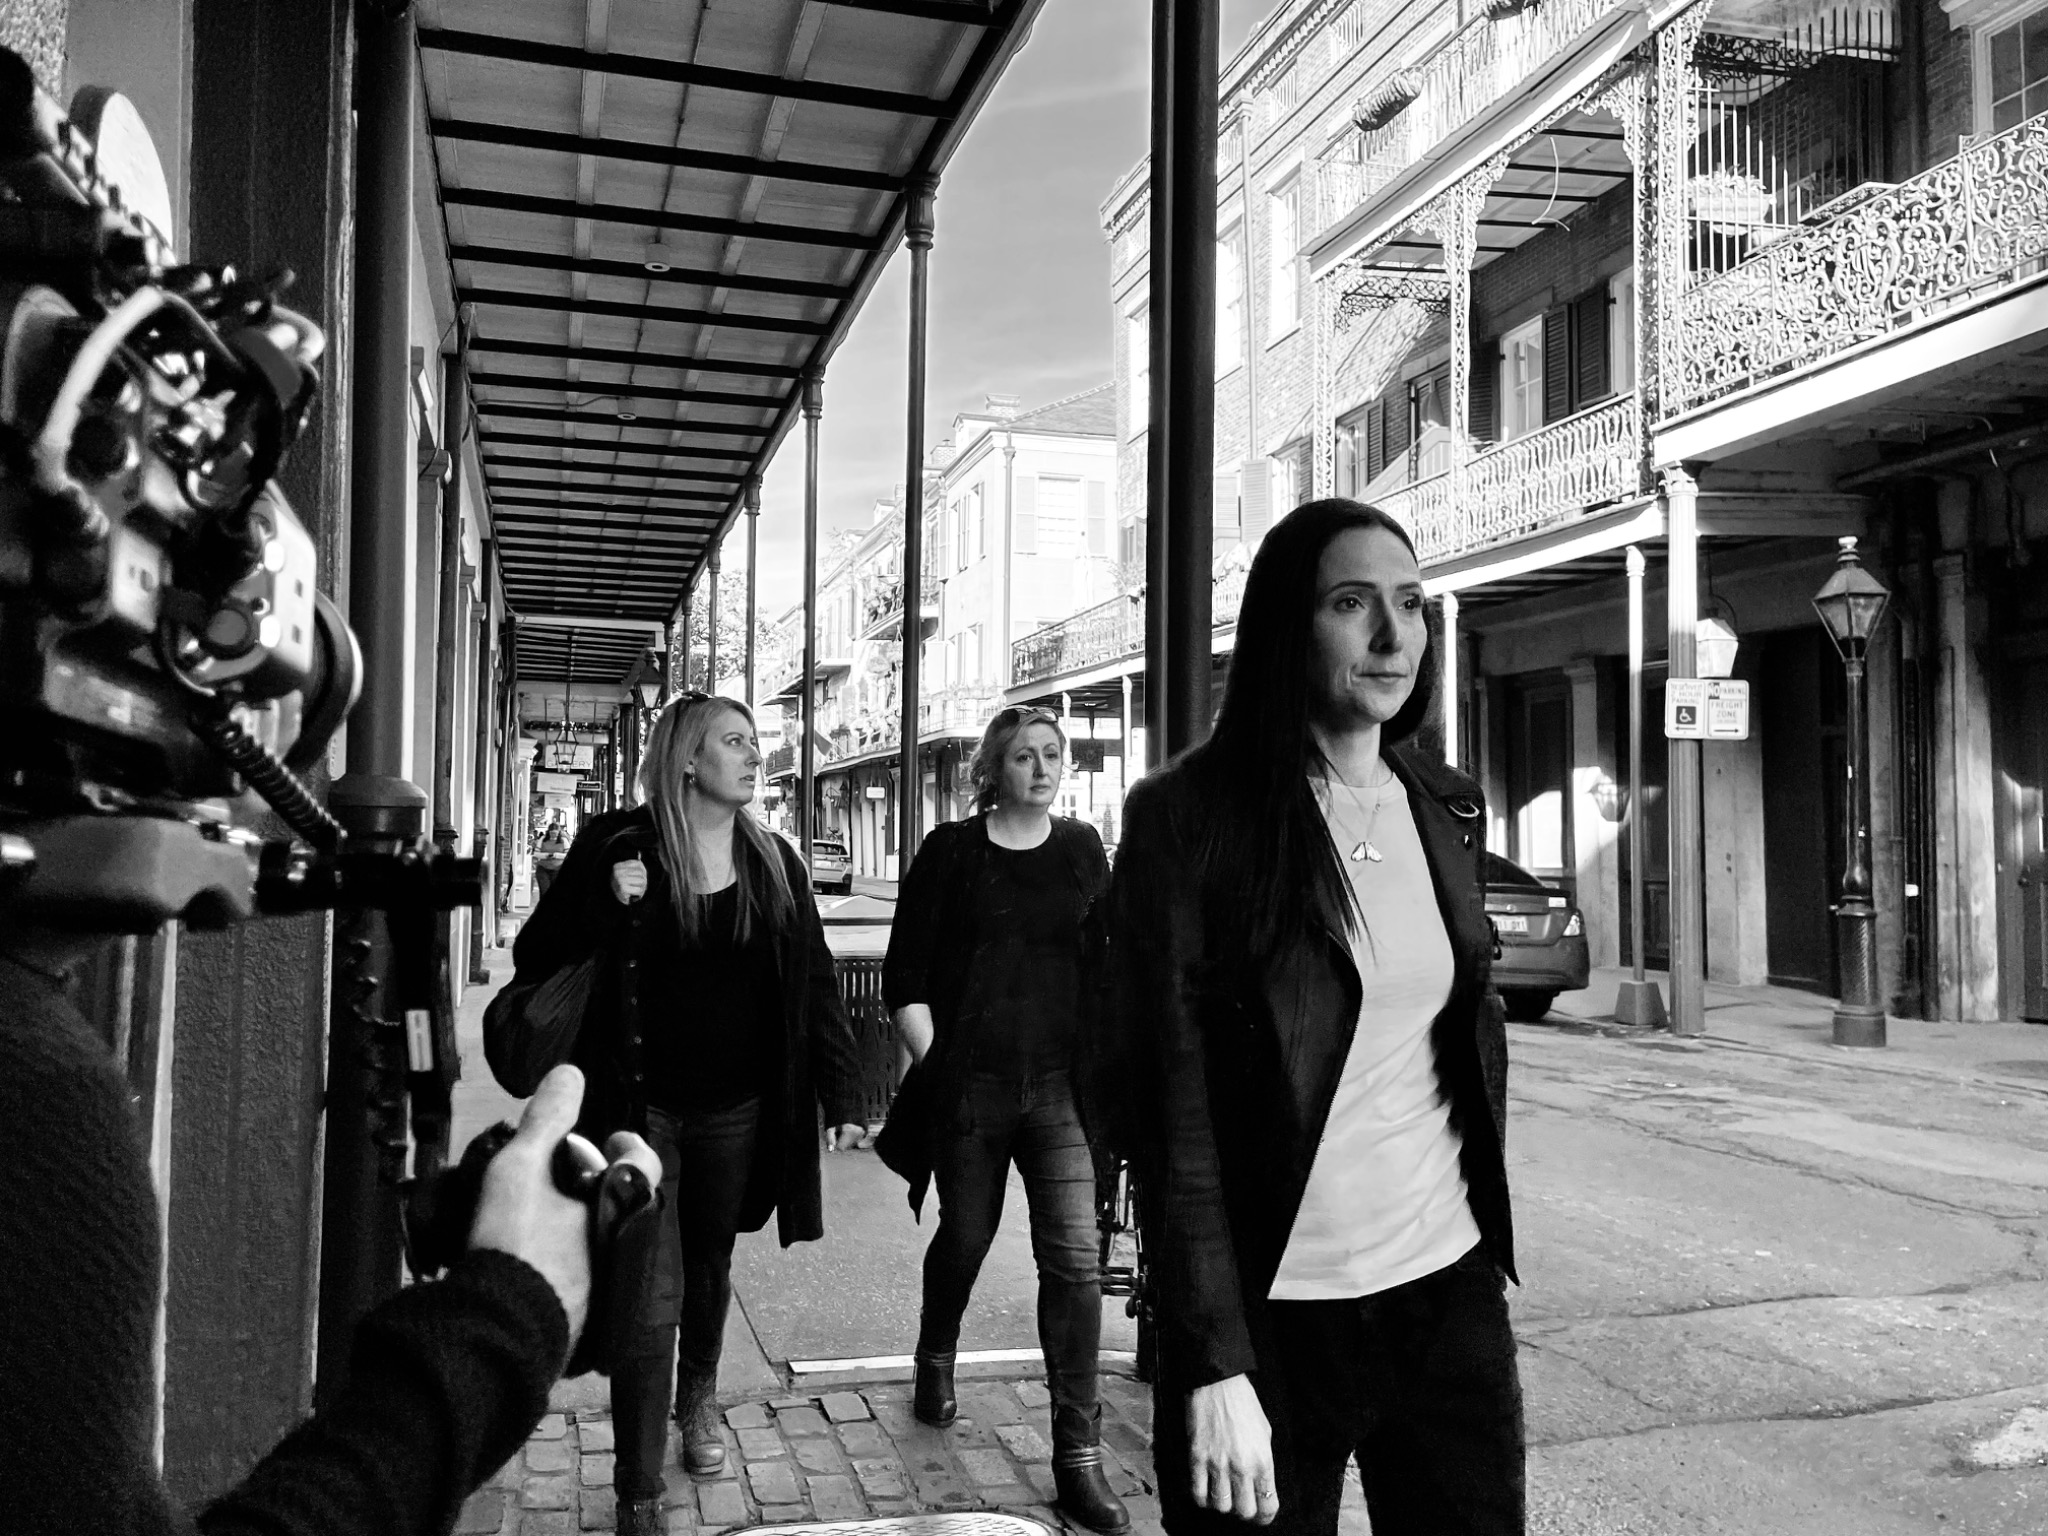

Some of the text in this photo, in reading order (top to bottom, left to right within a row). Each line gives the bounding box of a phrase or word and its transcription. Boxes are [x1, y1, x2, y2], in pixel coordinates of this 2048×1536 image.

[1708, 684, 1746, 697] NO PARKING
[1671, 697, 1700, 705] PARKING
[1711, 701, 1743, 709] FREIGHT
[1716, 710, 1737, 718] ZONE
[546, 760, 592, 768] GERY
